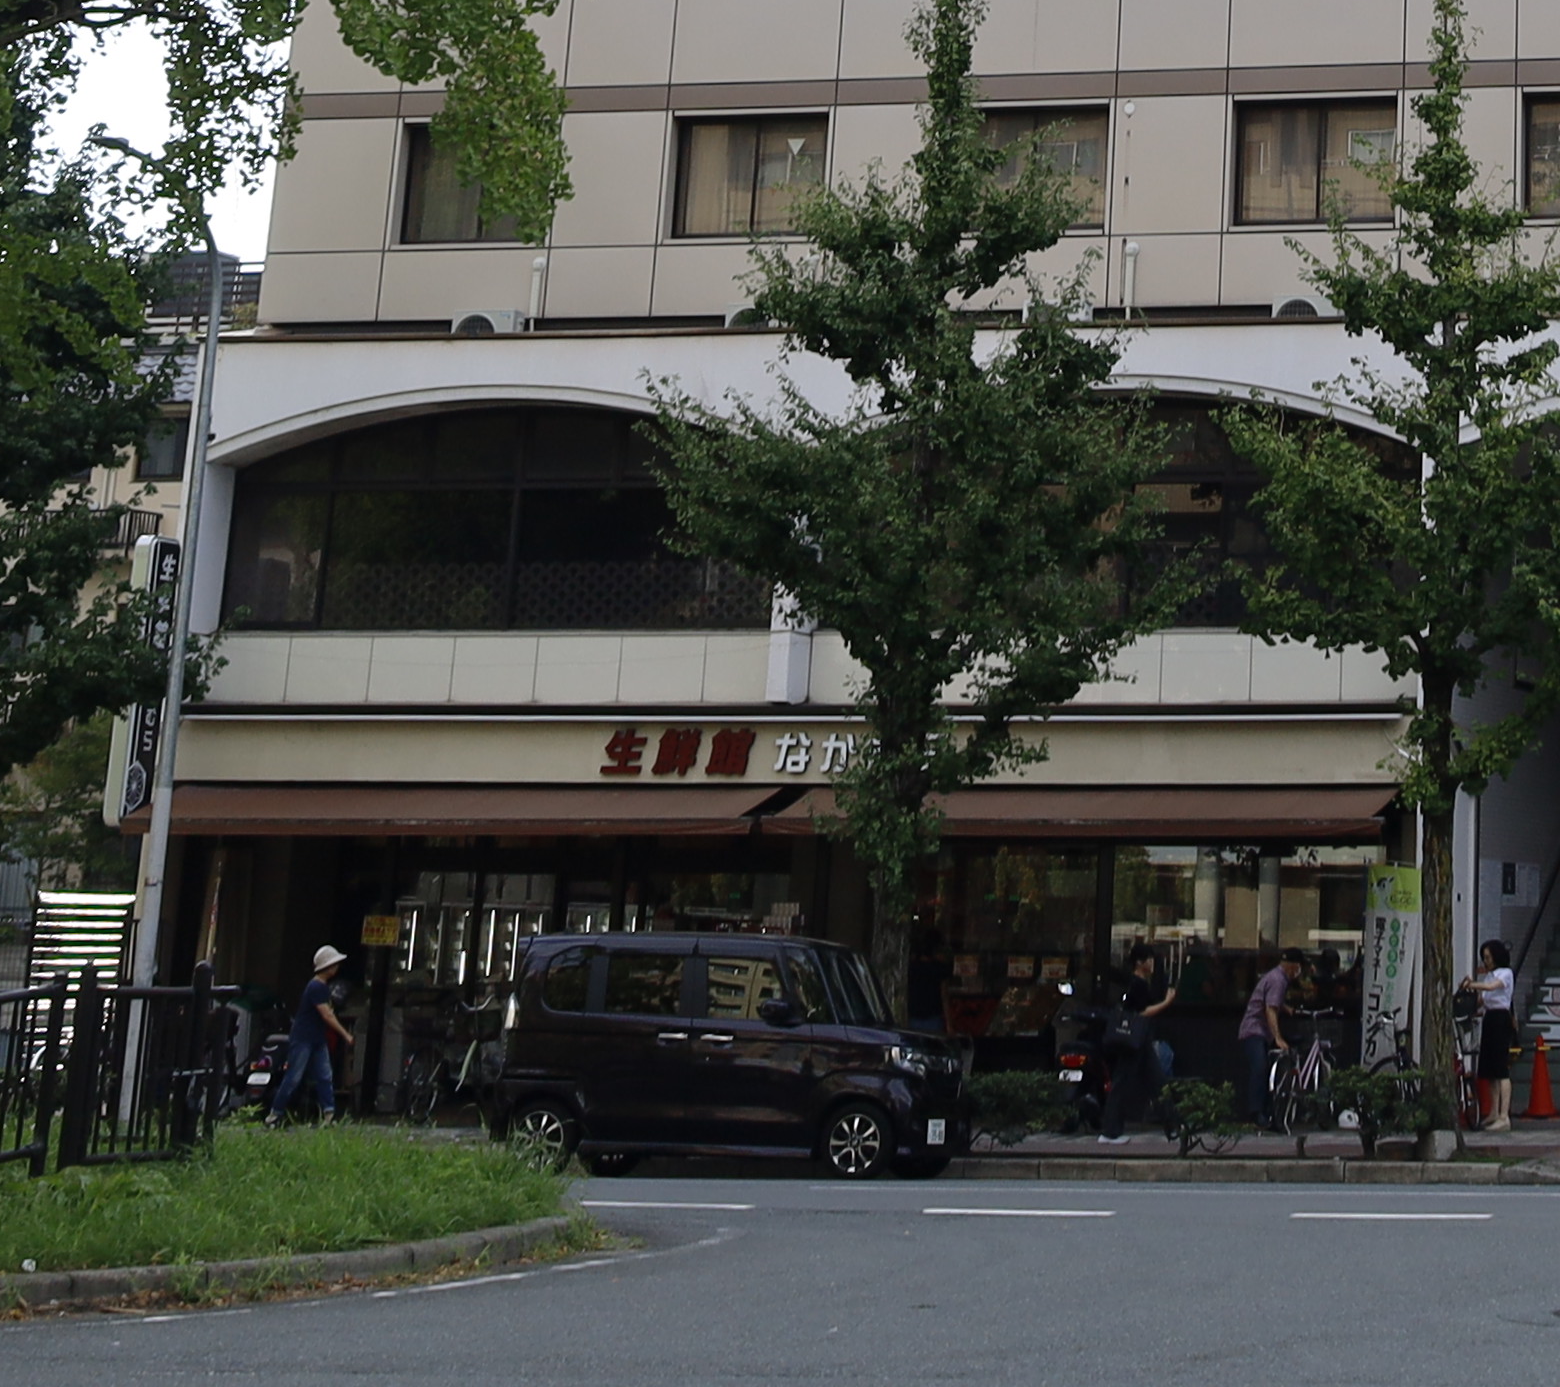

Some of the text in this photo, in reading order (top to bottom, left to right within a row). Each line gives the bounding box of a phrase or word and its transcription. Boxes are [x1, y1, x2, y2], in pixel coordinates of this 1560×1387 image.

[599, 727, 948, 777] 生鮮館 なか
